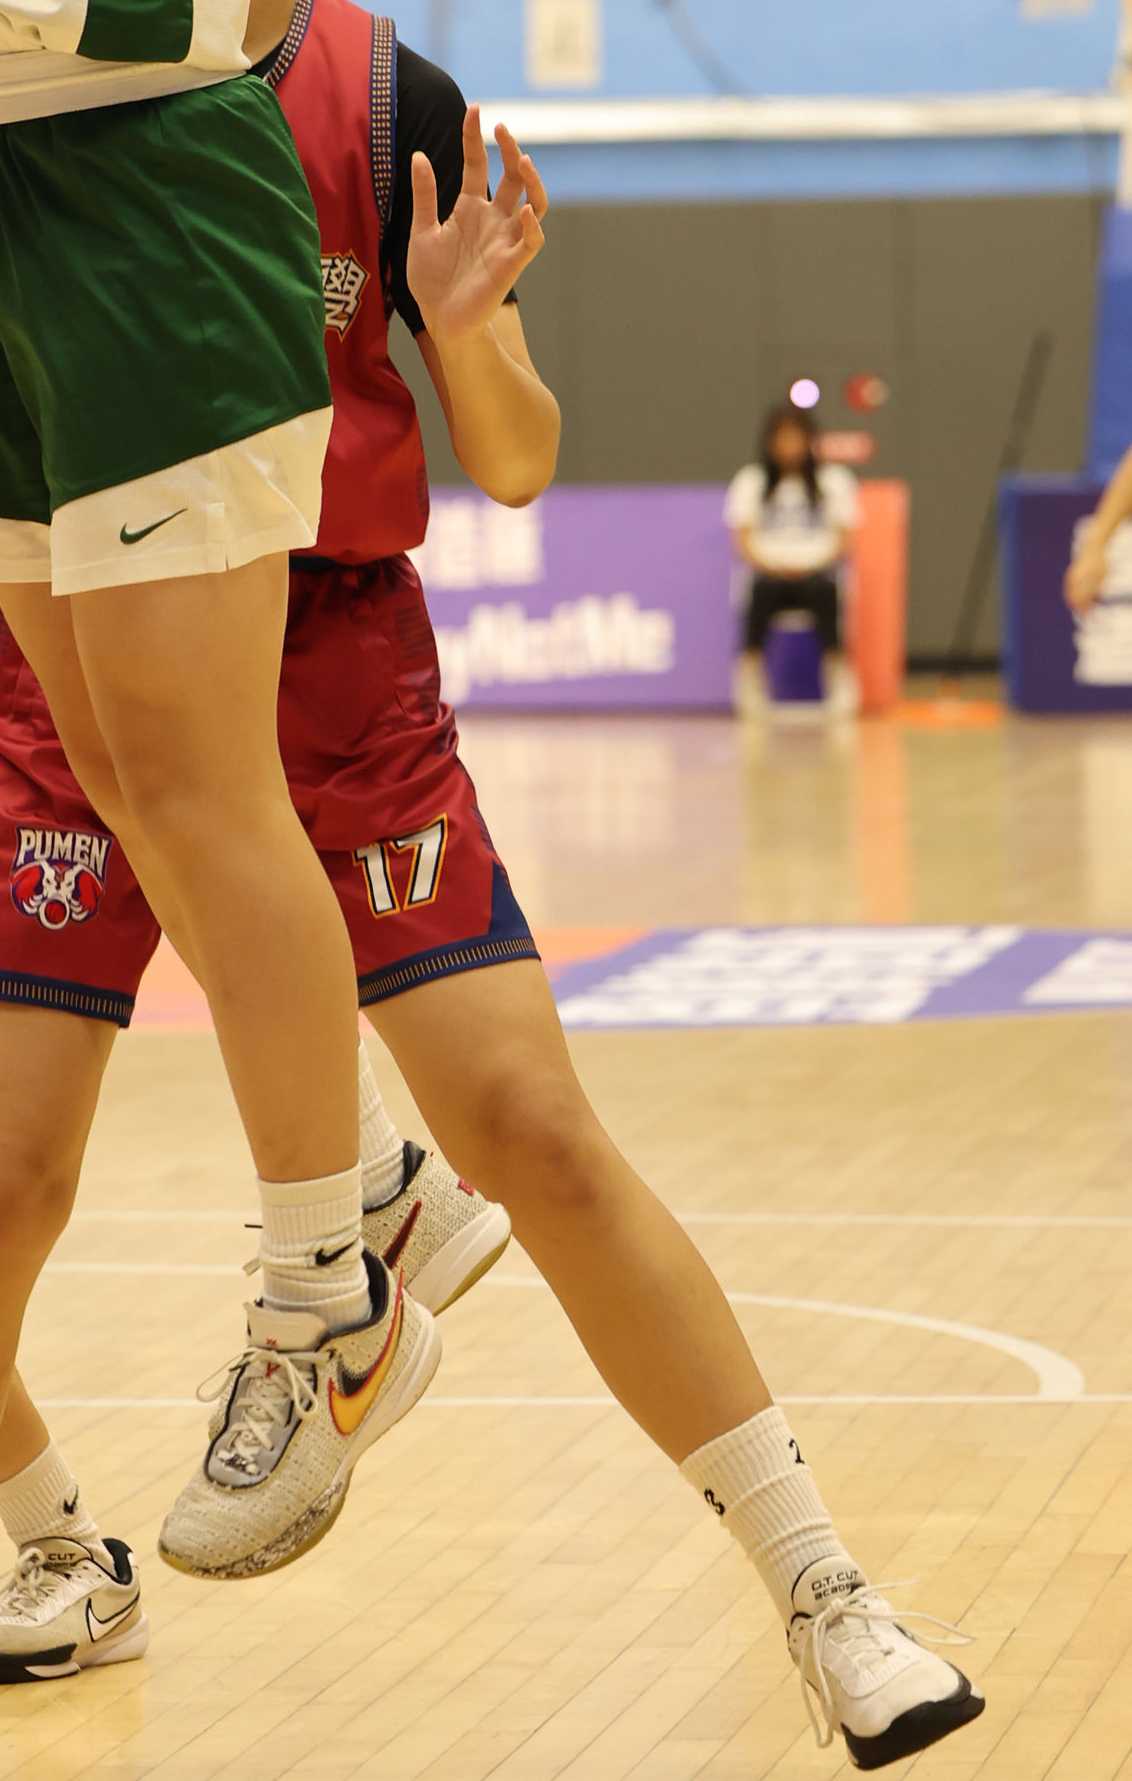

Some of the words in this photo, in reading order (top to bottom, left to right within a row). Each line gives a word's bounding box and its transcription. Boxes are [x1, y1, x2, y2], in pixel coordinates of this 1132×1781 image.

[16, 828, 109, 879] PUMEN
[352, 812, 448, 918] 17
[48, 1552, 76, 1561] CUT
[837, 1570, 859, 1582] CUT
